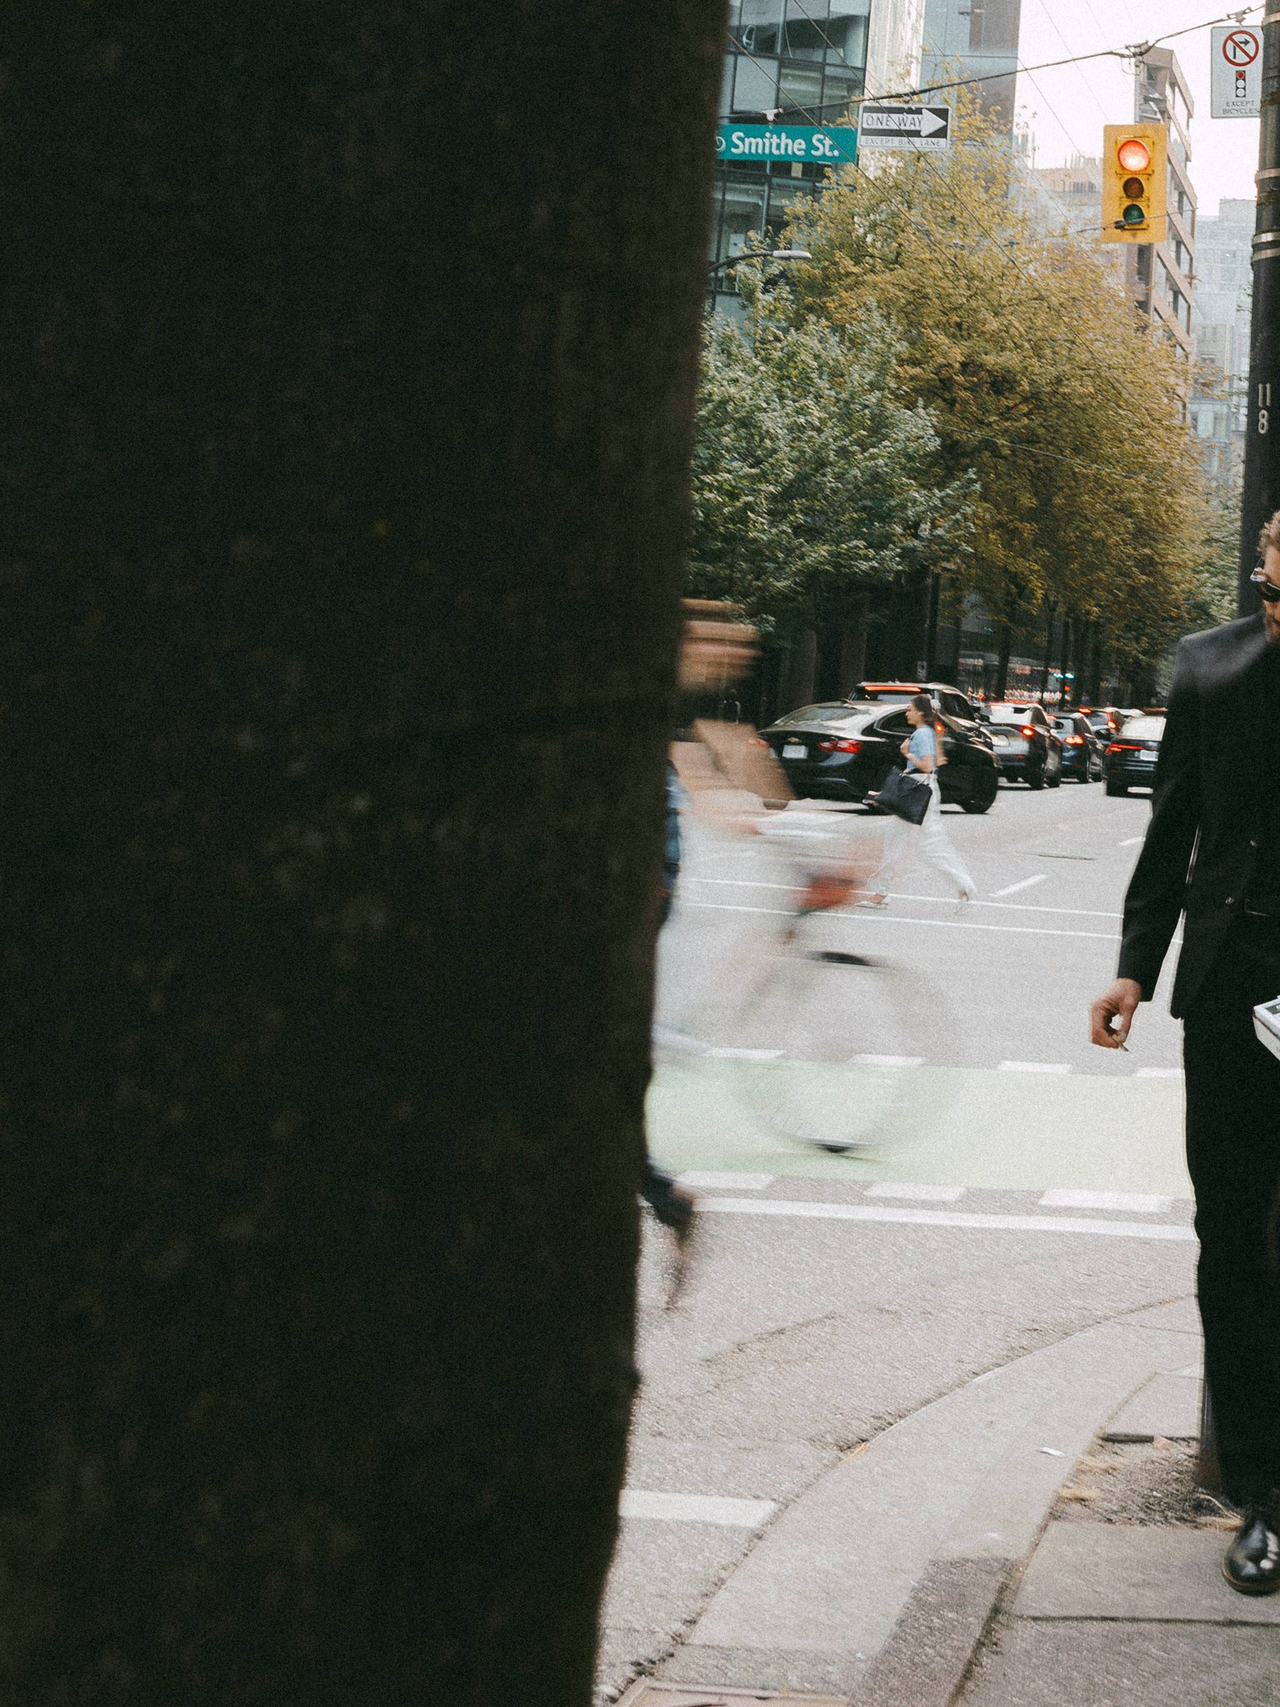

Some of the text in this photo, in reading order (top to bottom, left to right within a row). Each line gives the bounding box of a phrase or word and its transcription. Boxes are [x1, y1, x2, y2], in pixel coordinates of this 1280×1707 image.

[866, 114, 923, 127] ONE WAY
[730, 131, 840, 158] Smithe St.
[865, 137, 894, 146] EXCEPT
[920, 138, 941, 147] LANE
[1258, 383, 1271, 407] 11
[1258, 409, 1269, 434] 8
